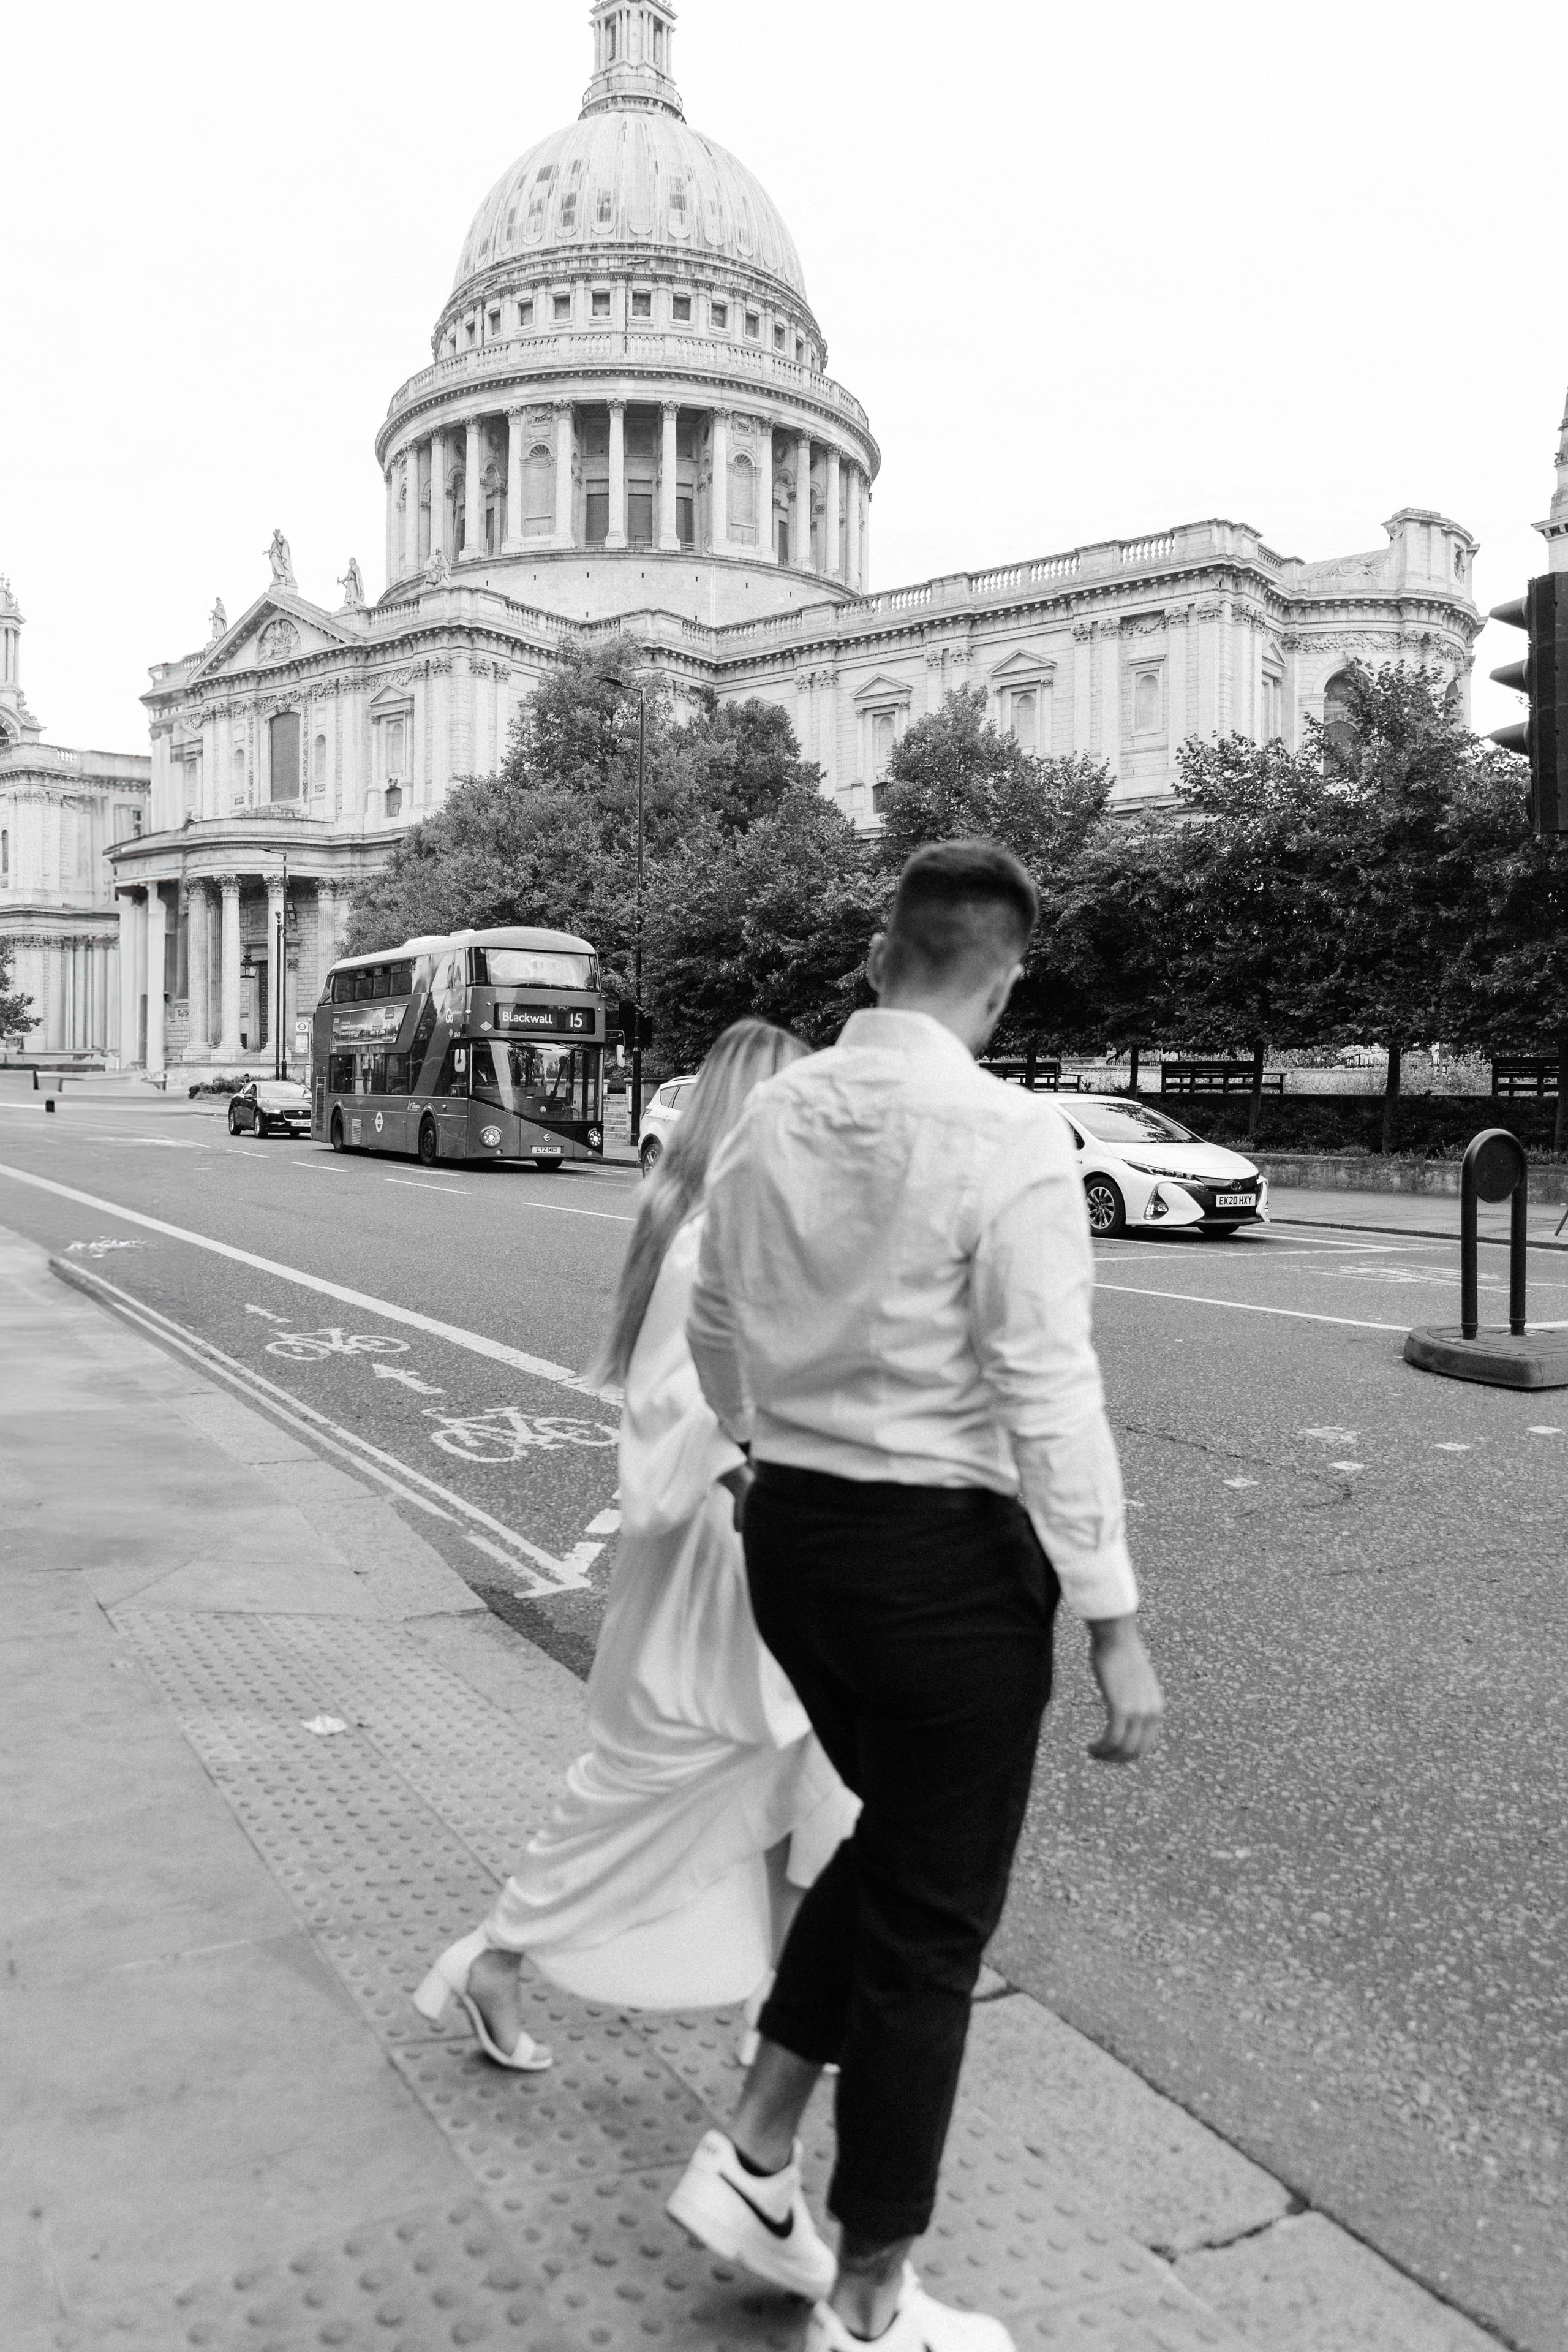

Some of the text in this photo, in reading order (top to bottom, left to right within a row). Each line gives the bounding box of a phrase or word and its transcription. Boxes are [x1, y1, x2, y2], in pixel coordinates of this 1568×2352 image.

[502, 1012, 583, 1028] Blackwall 15
[1219, 1195, 1253, 1205] EK20 HXY
